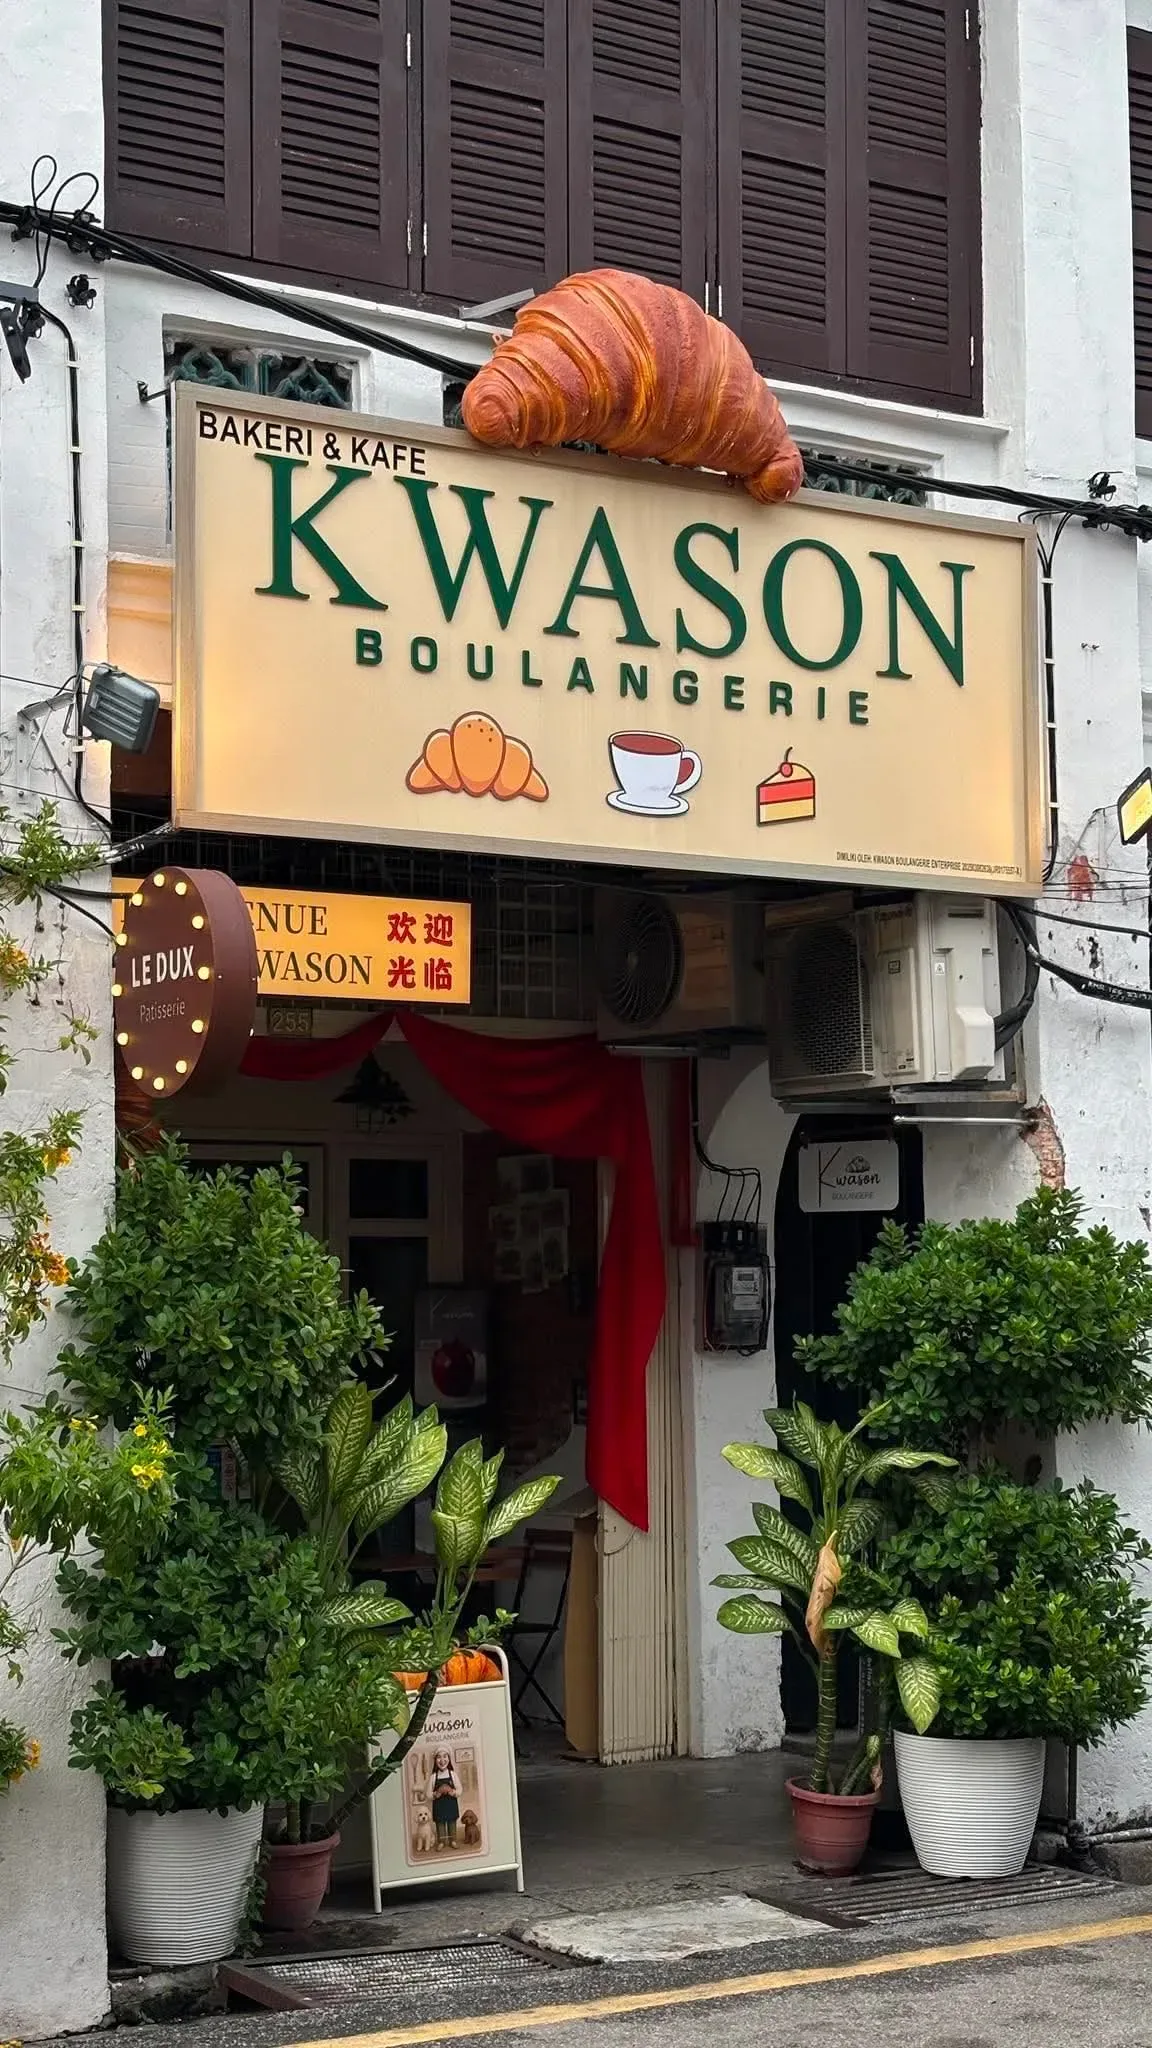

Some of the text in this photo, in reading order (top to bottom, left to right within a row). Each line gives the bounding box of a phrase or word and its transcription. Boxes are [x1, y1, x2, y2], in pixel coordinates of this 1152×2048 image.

[199, 410, 427, 475] BAKERI & KAFE
[254, 453, 976, 688] KWASON
[355, 628, 870, 726] BOULANGERIE
[873, 855, 895, 865] KWASON
[895, 857, 931, 868] BOULANGERIE
[931, 859, 961, 871] ENTERPRISE
[244, 901, 328, 936] NUE
[387, 911, 453, 947] 欢迎
[132, 945, 194, 988] LE DUX
[256, 949, 373, 985] WASON
[387, 955, 452, 991] 光临
[140, 998, 185, 1023] Patisserie
[272, 1010, 308, 1032] 255
[818, 1145, 880, 1208] Kwason
[419, 1718, 473, 1736] wason
[426, 1731, 469, 1743] BOULANGERIE
